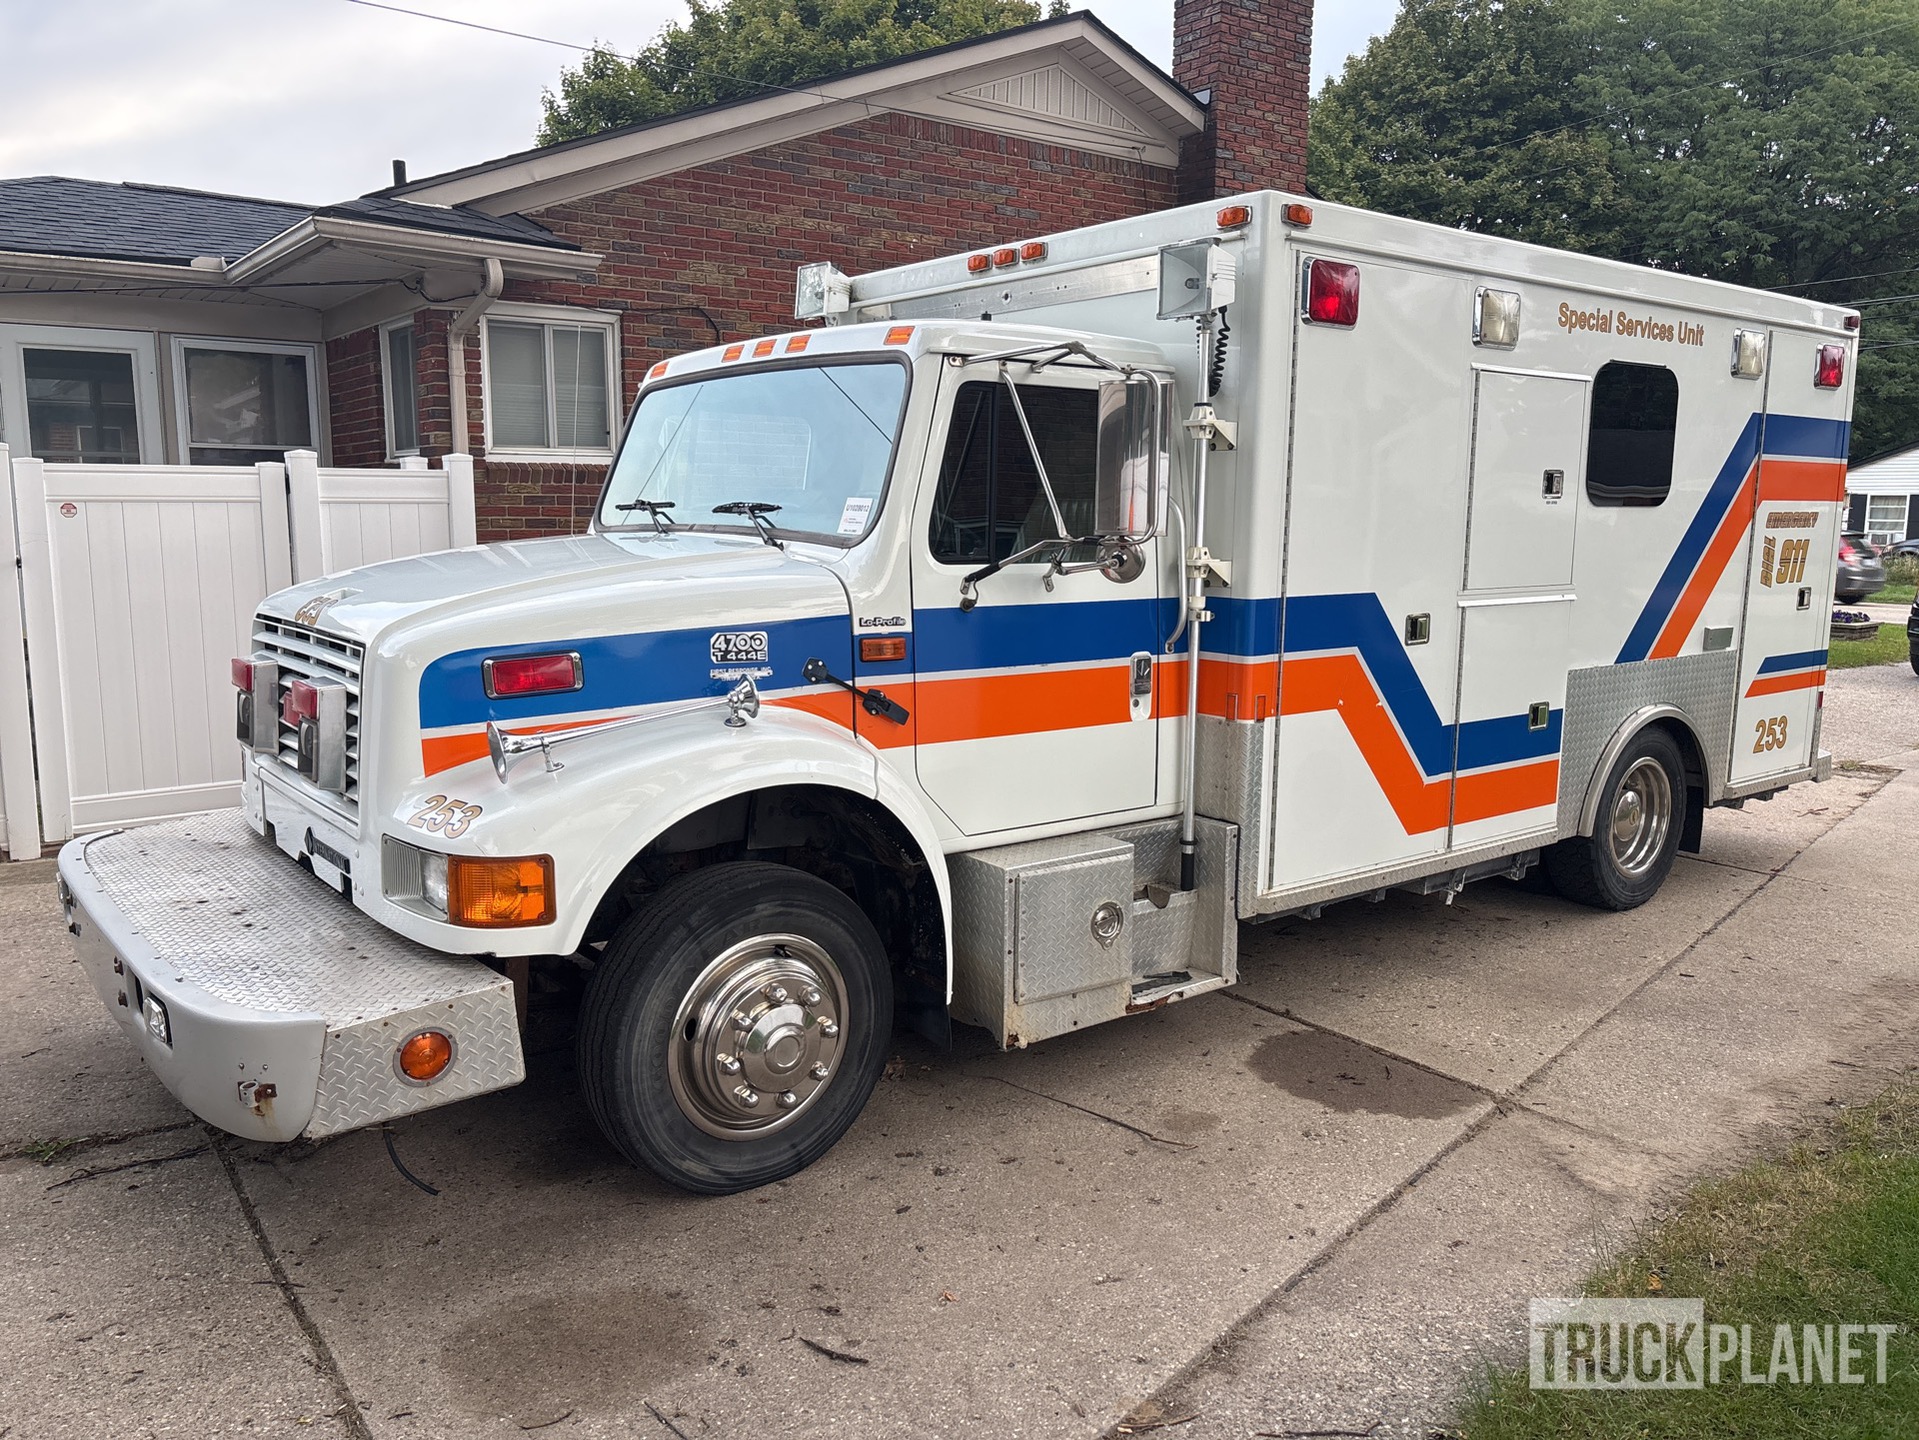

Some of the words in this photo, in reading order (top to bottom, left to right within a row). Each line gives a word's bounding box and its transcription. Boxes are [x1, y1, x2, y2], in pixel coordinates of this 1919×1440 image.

[1558, 302, 1613, 334] Special
[1616, 311, 1674, 342] Services
[1678, 321, 1704, 346] Unit
[1766, 512, 1819, 528] EMERGENCY
[1776, 539, 1810, 584] 911
[859, 616, 906, 627] Lo-Profile
[713, 633, 767, 651] 4700
[727, 651, 766, 661] 444E
[1753, 715, 1788, 753] 253
[407, 794, 483, 839] 253
